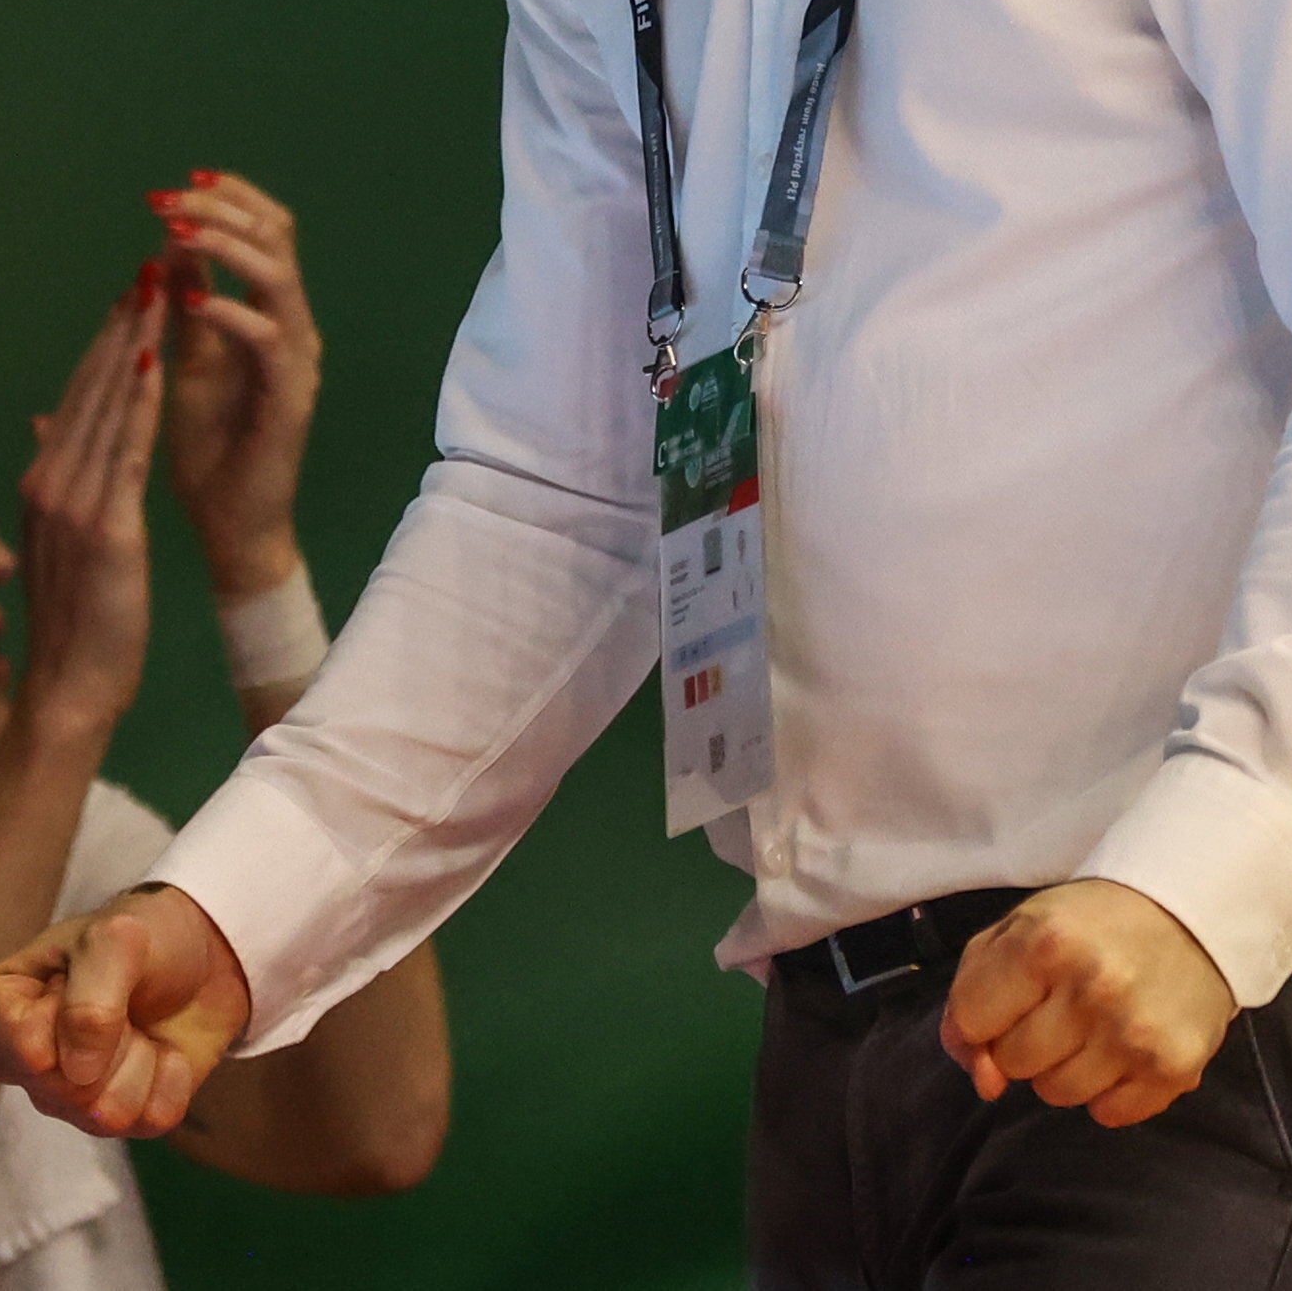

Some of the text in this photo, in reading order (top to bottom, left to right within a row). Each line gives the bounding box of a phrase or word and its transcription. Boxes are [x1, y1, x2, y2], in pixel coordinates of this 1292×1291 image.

[801, 97, 815, 124] from
[791, 129, 806, 178] recycled
[787, 180, 799, 200] PET
